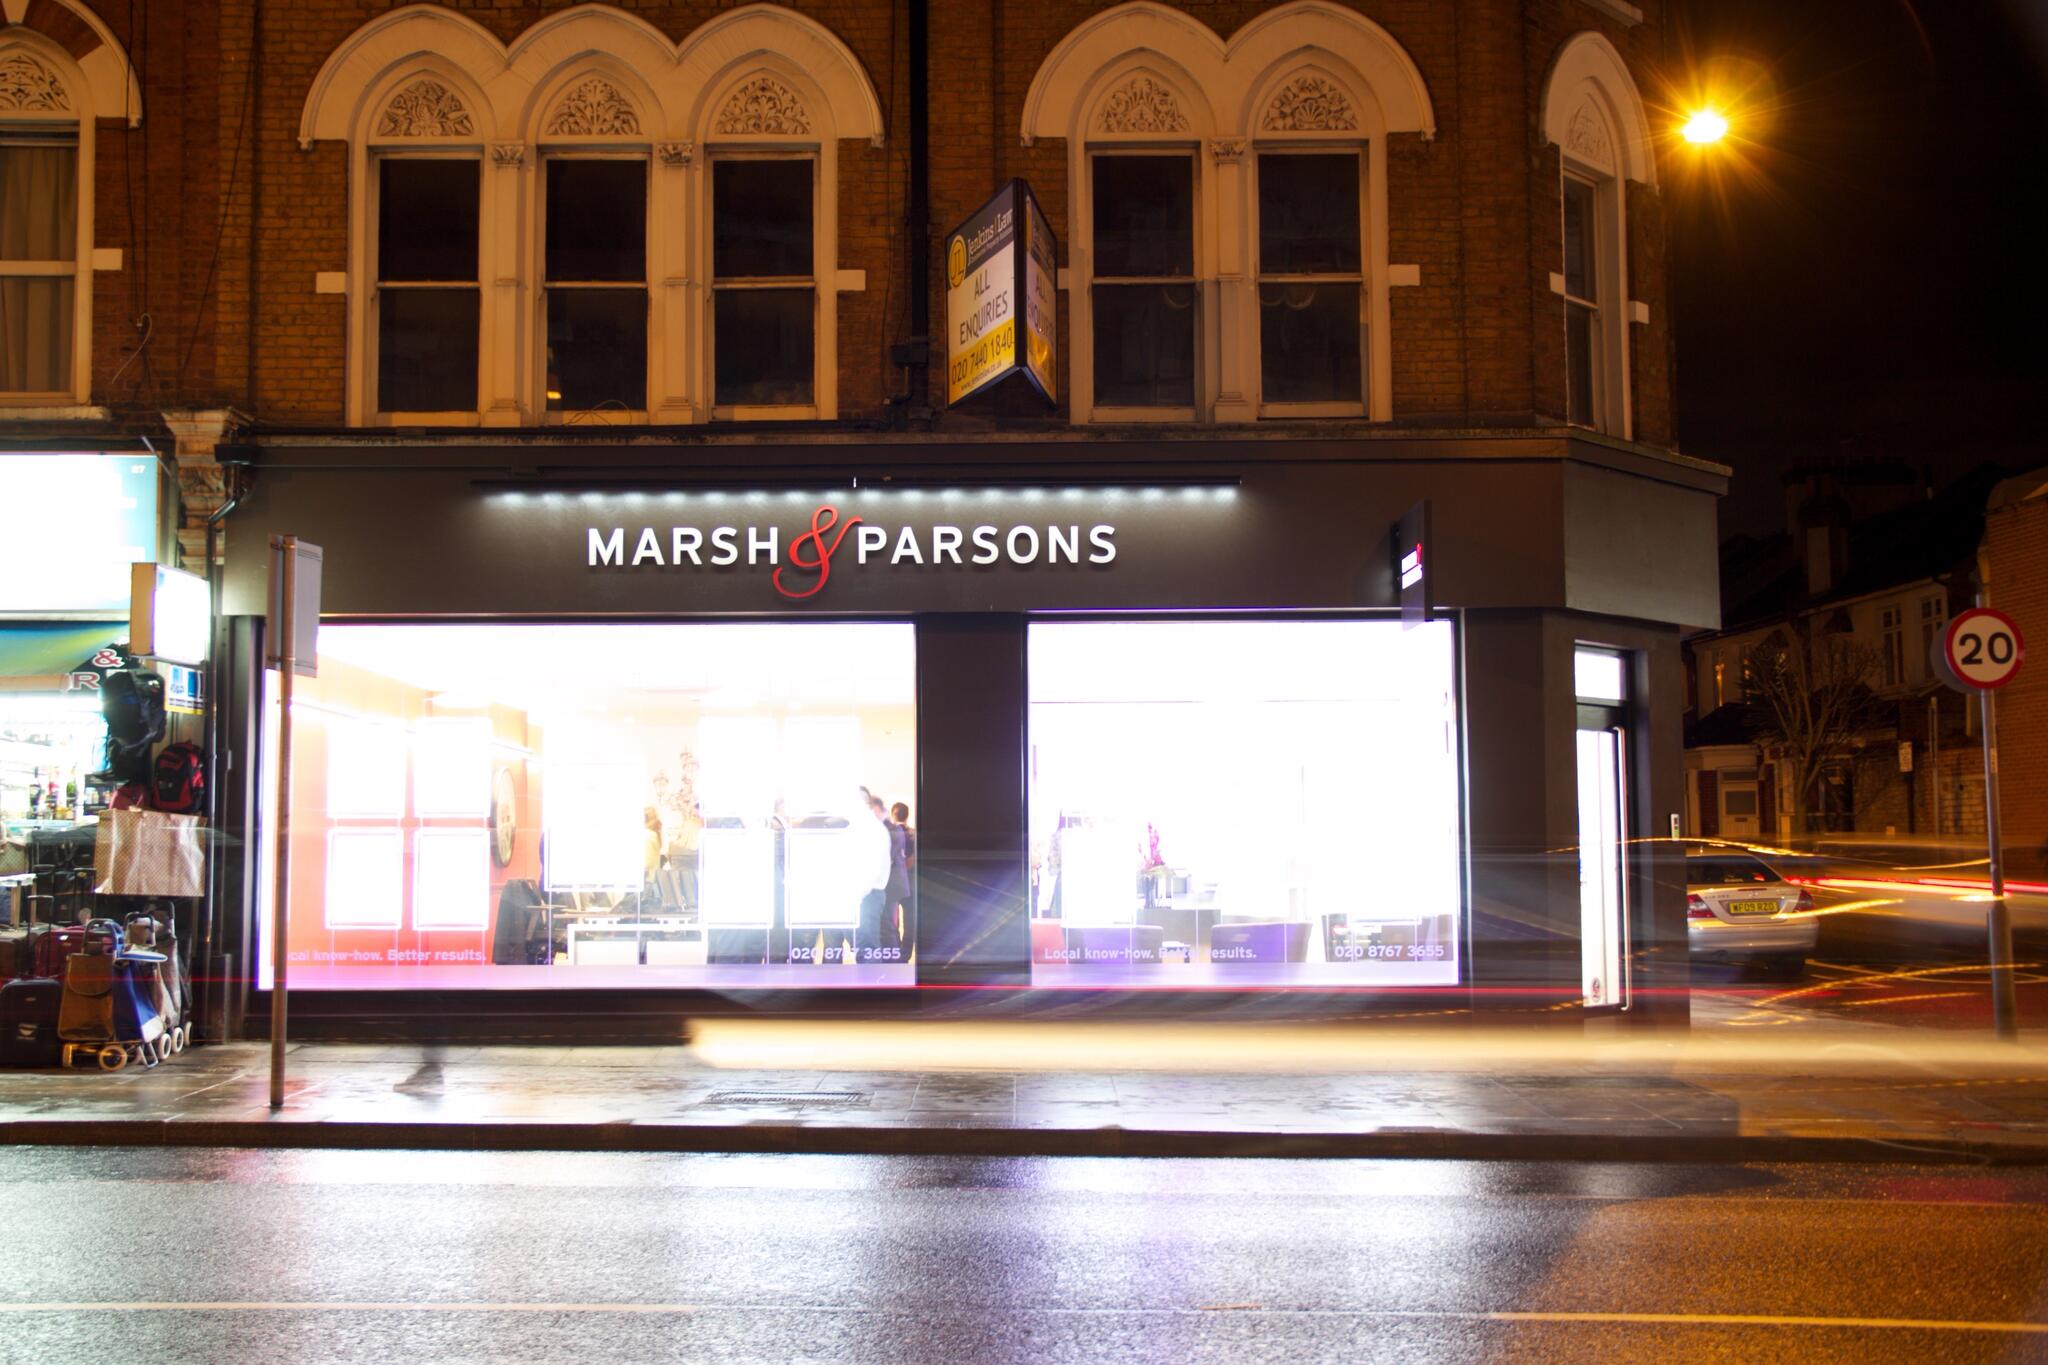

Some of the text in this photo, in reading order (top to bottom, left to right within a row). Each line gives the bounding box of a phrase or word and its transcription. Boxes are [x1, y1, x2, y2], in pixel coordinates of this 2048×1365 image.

[974, 269, 991, 301] ALL
[960, 290, 1008, 346] ENQUIRIES
[951, 358, 968, 386] 020
[970, 343, 988, 375] 7440
[991, 327, 1013, 360] 1840
[587, 504, 1118, 599] MARSH & PARSONS
[1958, 631, 2014, 666] 20
[313, 948, 384, 961] know-how.
[387, 949, 431, 961] Better
[434, 949, 487, 961] results.
[825, 947, 860, 960] 877
[863, 947, 901, 960] 3655
[1044, 947, 1080, 960] Local
[1084, 947, 1154, 960] know-how.
[1207, 947, 1258, 959] esults.
[1334, 945, 1445, 958] 020 8767 3655
